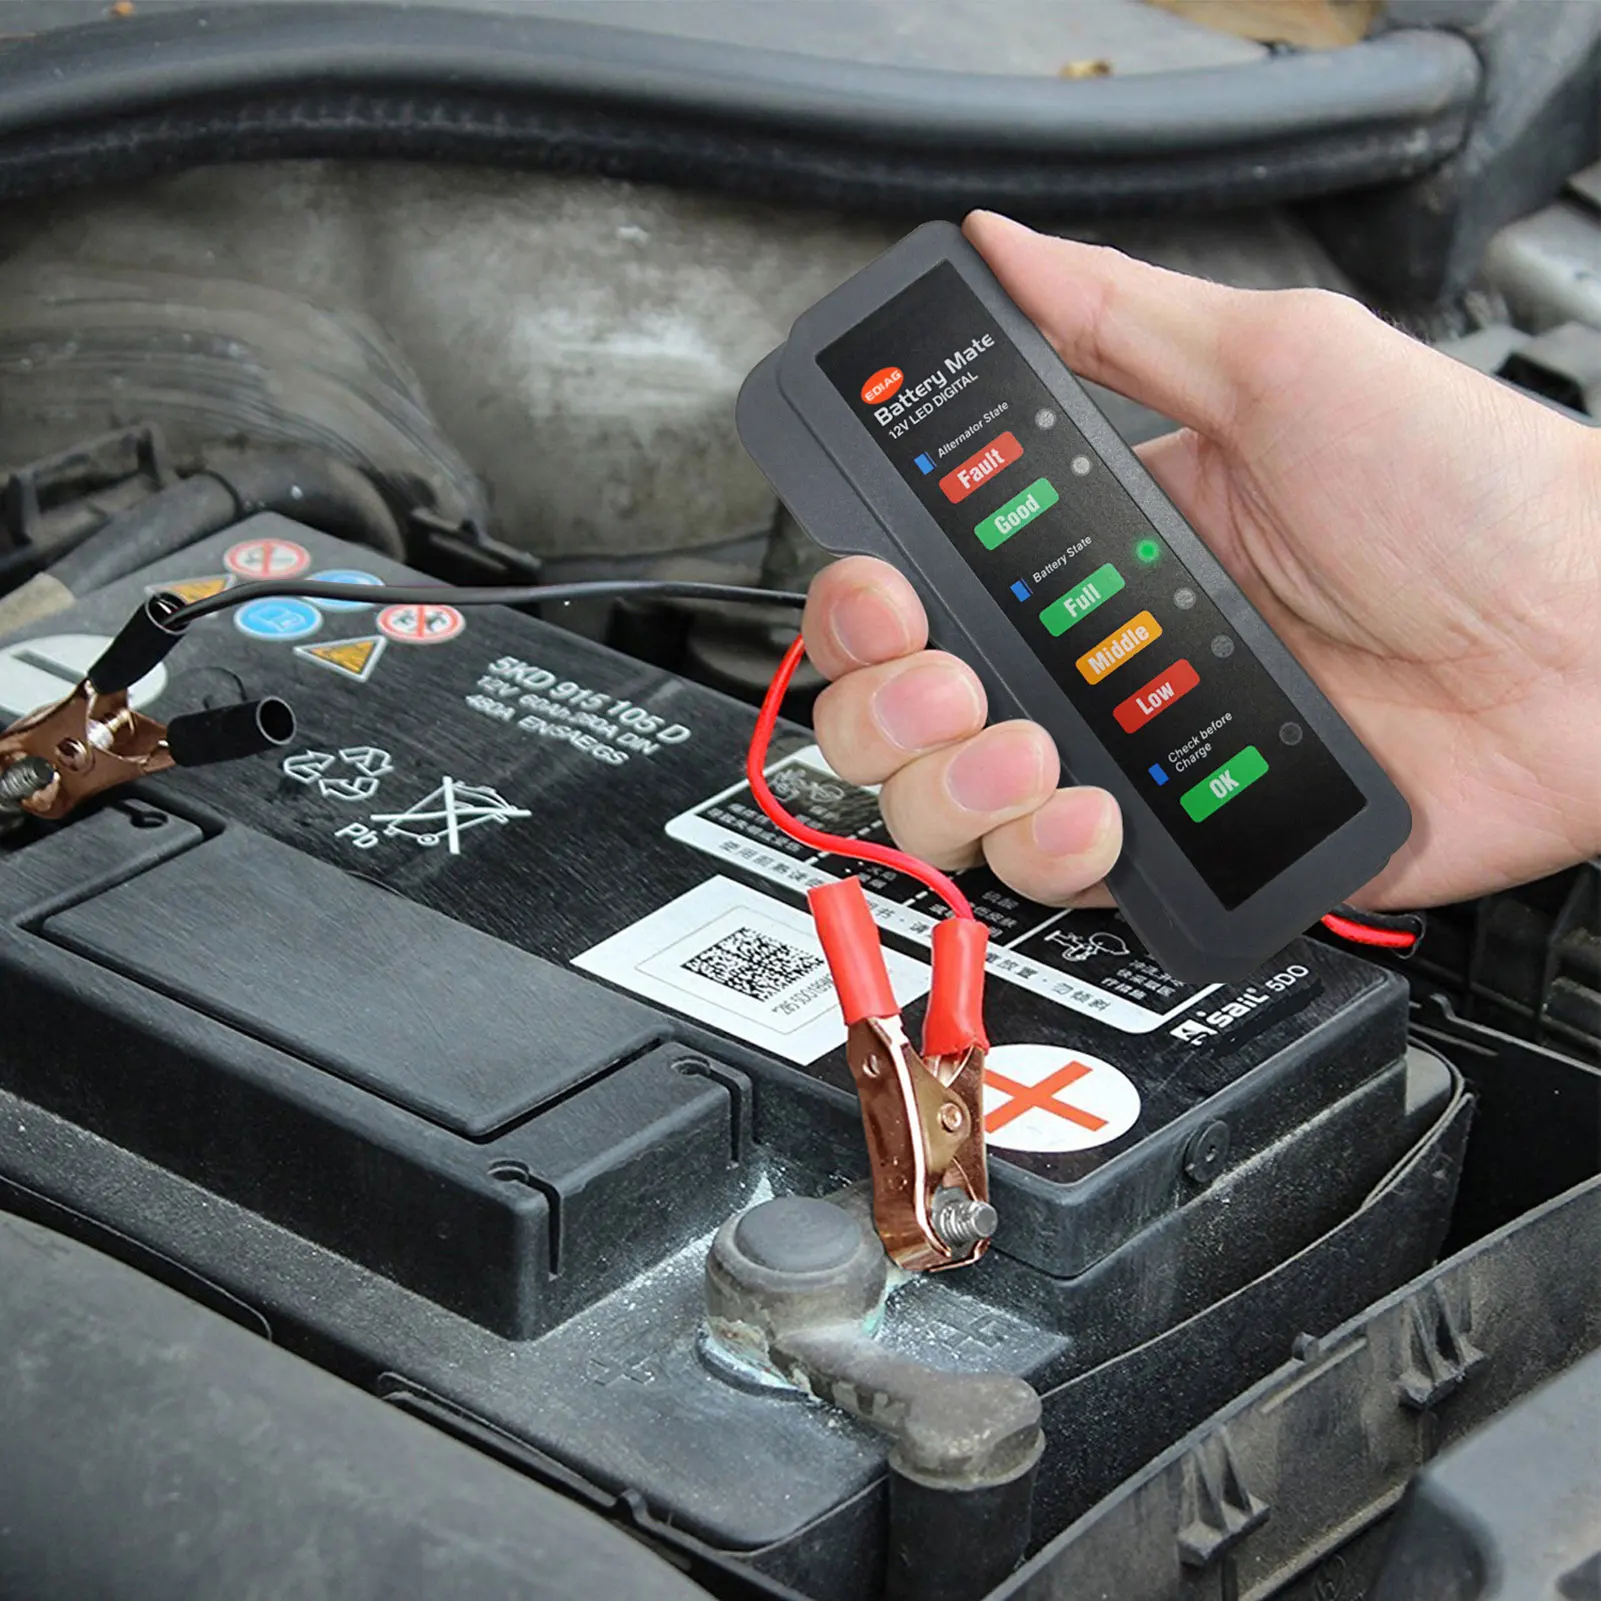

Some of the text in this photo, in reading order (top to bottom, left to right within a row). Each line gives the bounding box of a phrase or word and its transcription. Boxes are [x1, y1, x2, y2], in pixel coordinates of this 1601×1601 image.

[864, 370, 903, 402] EDIAG
[874, 333, 995, 427] Battery Mate
[888, 372, 979, 440] 12V LED DIGITAL
[937, 401, 1009, 458] Alternator State
[957, 447, 1005, 489] Fault
[994, 494, 1041, 535] Good
[1032, 535, 1092, 583] Battery State
[1063, 583, 1101, 618] Full
[1087, 624, 1150, 676] Middle
[476, 675, 521, 698] 12V
[616, 732, 661, 755] DIN
[488, 656, 692, 744] 5KD 915 105 D
[1135, 682, 1175, 716] Low
[1168, 712, 1233, 764] Check before
[1175, 742, 1212, 773] Charge
[1208, 769, 1240, 799] OK
[334, 822, 379, 849] Pb
